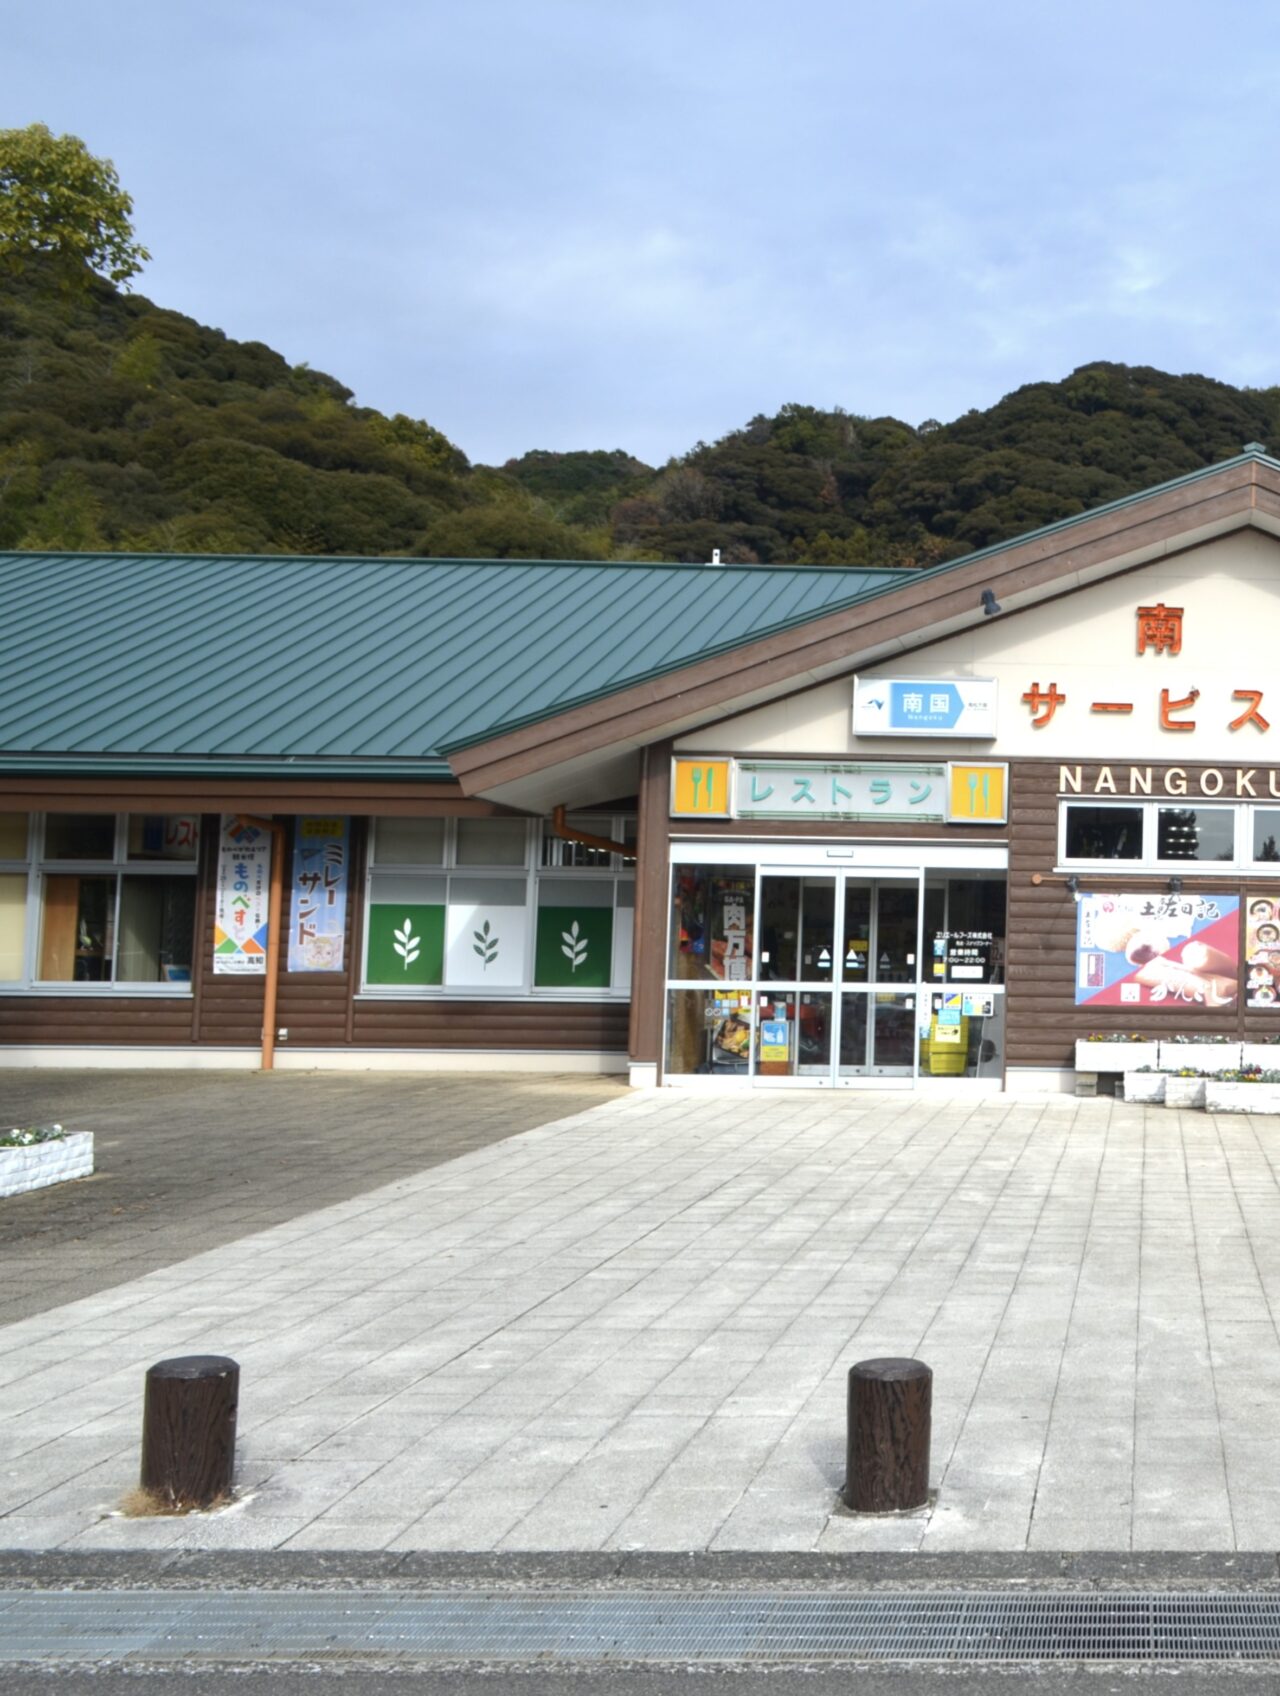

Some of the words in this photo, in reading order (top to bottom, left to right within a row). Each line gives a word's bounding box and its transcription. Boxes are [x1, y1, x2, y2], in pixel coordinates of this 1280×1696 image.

[902, 692, 950, 714] 南国
[750, 776, 932, 805] レストラン
[323, 844, 343, 906] ミレー
[299, 873, 321, 945] サンド
[1139, 897, 1221, 919] 土佐日記
